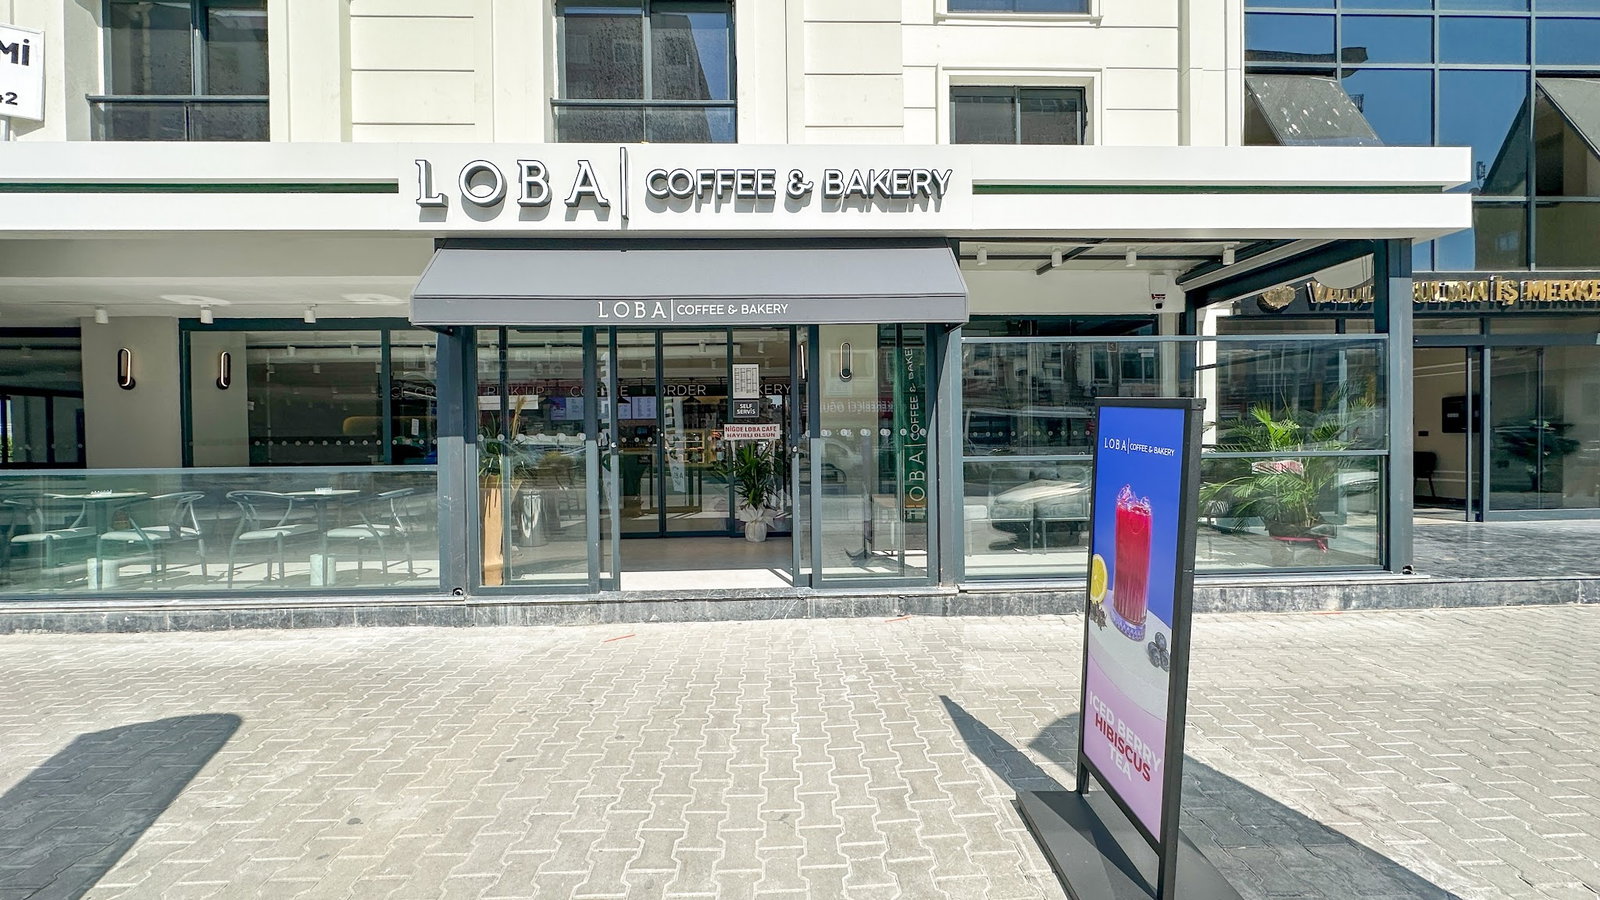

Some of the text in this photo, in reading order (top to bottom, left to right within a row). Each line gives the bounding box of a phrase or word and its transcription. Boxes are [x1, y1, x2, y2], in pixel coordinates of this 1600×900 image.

[415, 159, 953, 208] LOBA COFFEE & BAKERY
[1490, 275, 1519, 305] İŞ
[598, 301, 789, 318] LOBA COFFEE & BAKERY
[904, 347, 914, 380] BAKE
[487, 385, 520, 396] PIK
[663, 384, 707, 396] RDER
[759, 383, 791, 395] KERY
[909, 395, 920, 441] COFFEE
[1104, 437, 1127, 451] LOBA
[1129, 443, 1148, 453] COFFEE
[1153, 446, 1176, 457] BAKERY
[1089, 690, 1162, 773] ICED BERRY
[1095, 712, 1151, 782] HIBISCUS
[1108, 743, 1133, 782] TEA
